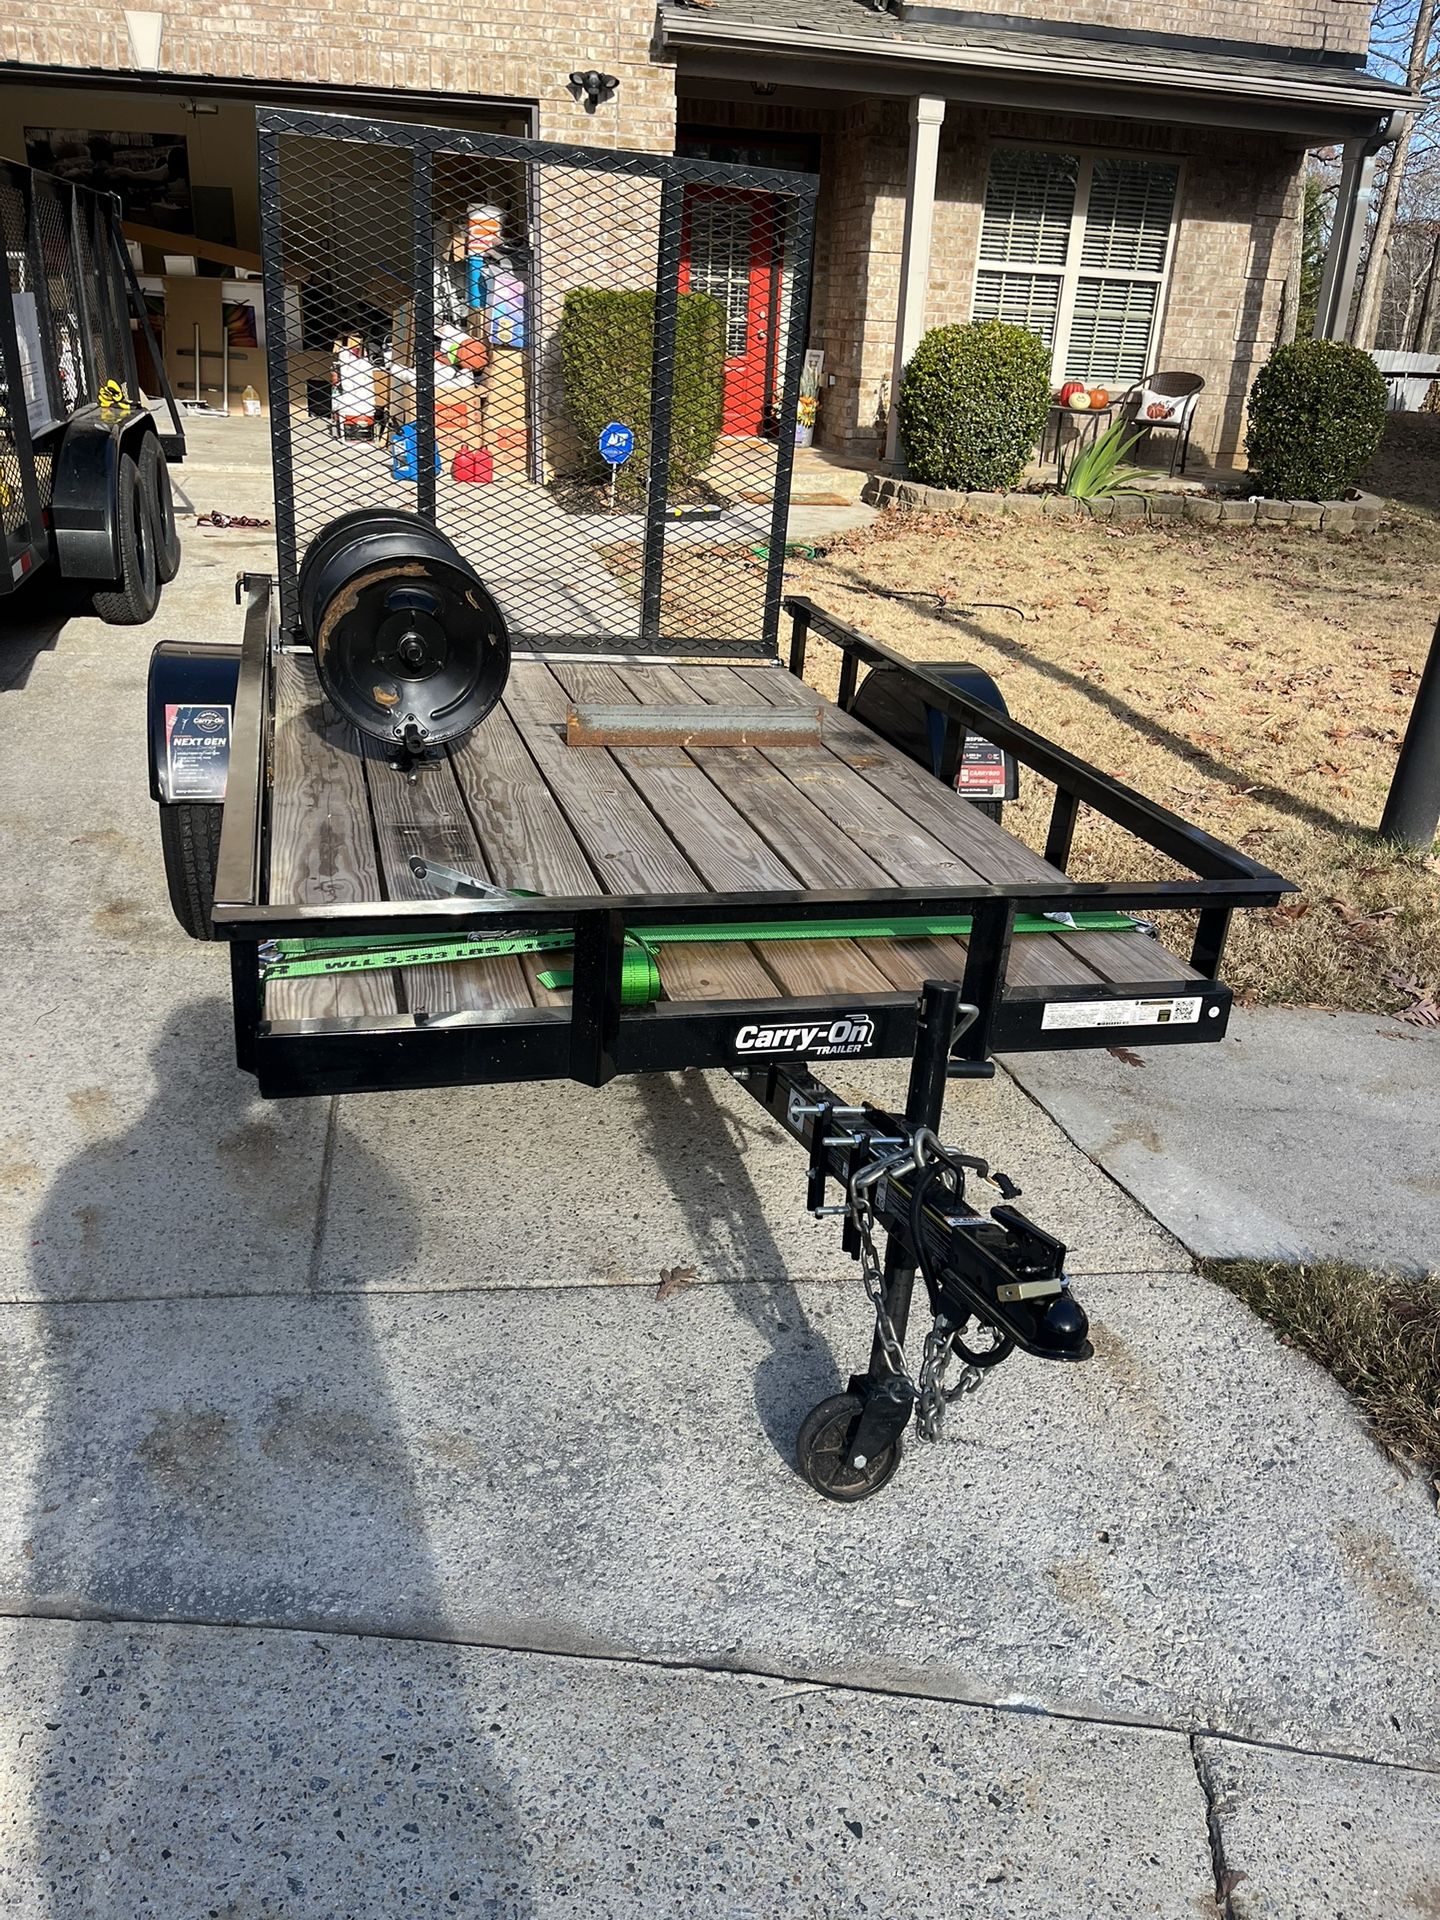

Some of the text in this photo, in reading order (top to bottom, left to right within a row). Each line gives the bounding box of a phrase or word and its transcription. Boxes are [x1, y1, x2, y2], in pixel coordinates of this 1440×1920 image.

[173, 737, 227, 746] NEXT GEN
[324, 959, 375, 970] WLL
[456, 946, 500, 957] LBS
[735, 1020, 868, 1051] Carry-On
[816, 1044, 861, 1055] TRAILER
